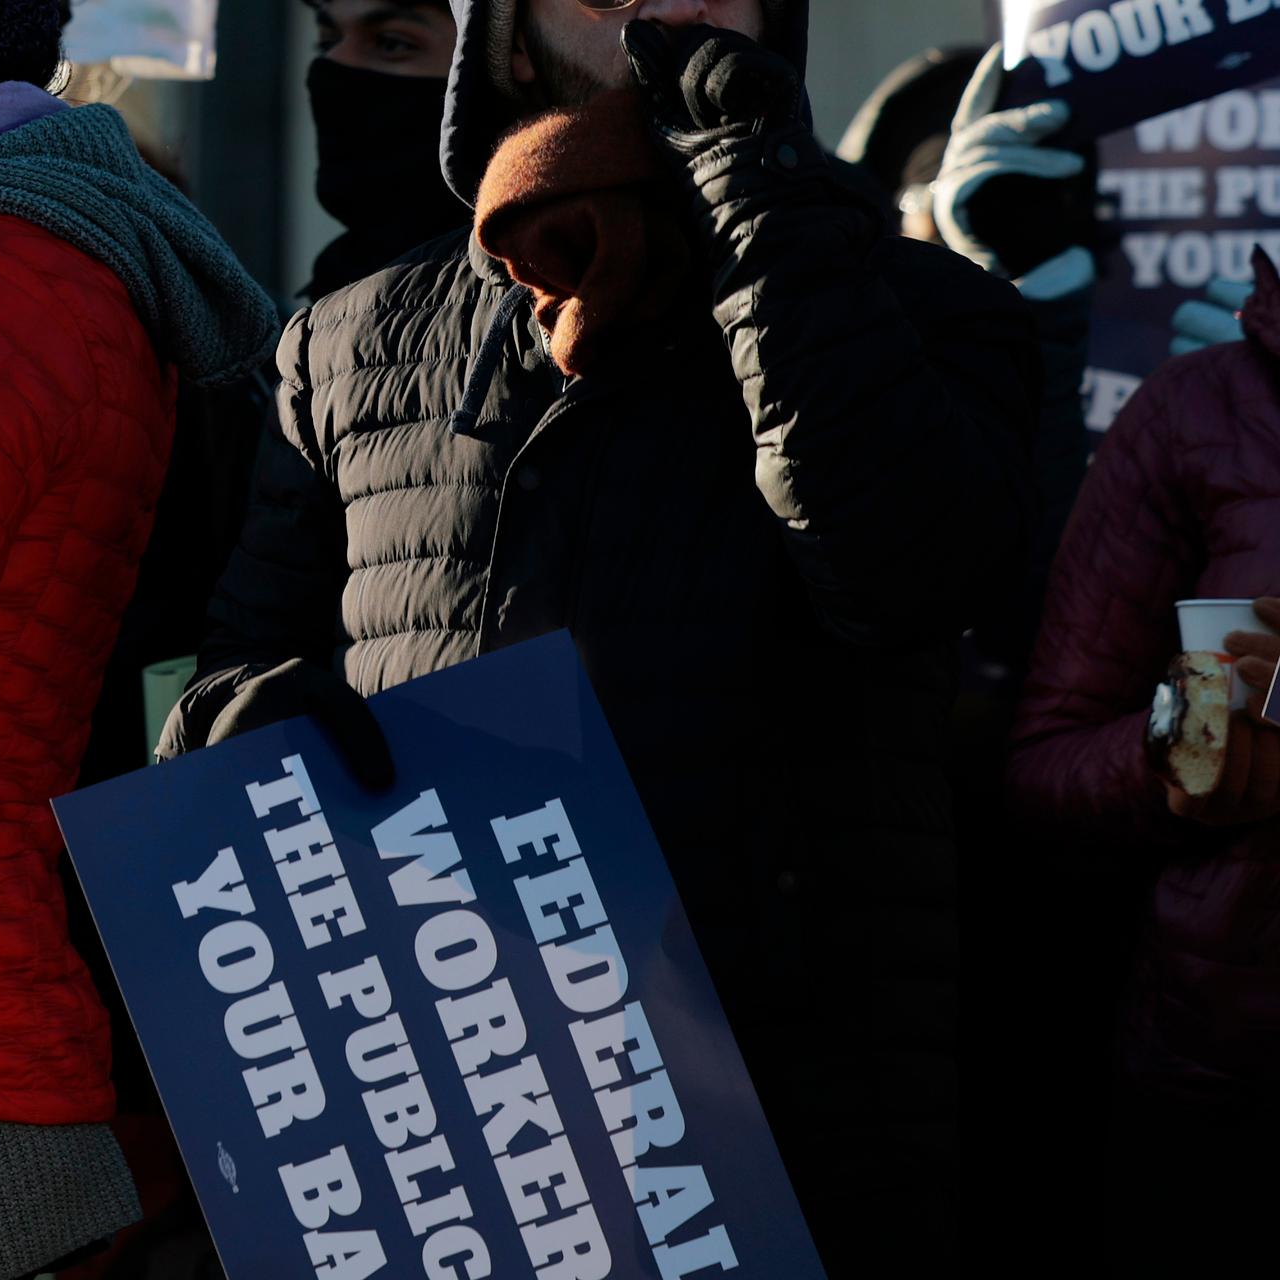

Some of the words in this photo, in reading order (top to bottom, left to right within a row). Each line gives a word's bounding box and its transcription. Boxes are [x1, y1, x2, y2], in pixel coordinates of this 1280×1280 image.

[172, 846, 327, 1140] YOUR
[245, 753, 367, 950] THE
[490, 797, 740, 1280] FEDERAL
